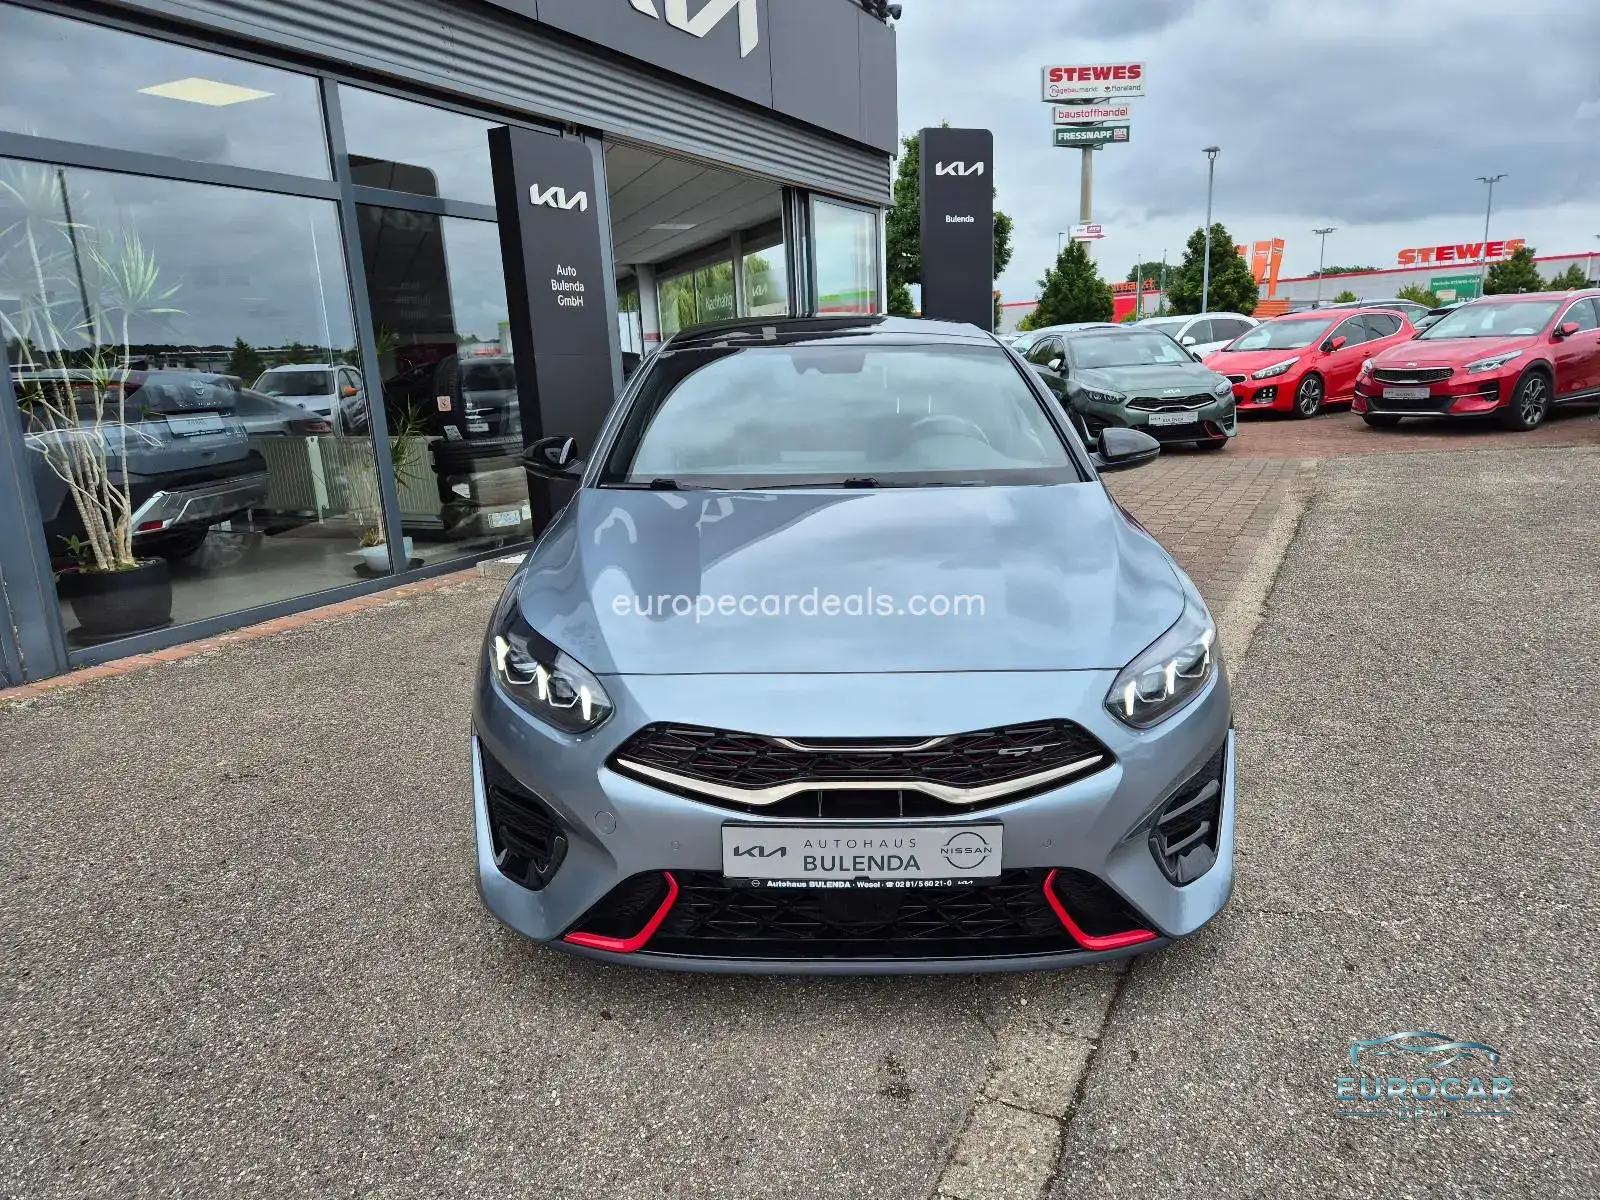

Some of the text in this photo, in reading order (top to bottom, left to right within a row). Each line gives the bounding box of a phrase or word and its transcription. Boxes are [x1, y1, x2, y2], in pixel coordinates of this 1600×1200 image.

[628, 0, 759, 58] IA
[1049, 64, 1142, 82] STEWES
[1058, 107, 1128, 119] baustoffhandel
[1058, 130, 1113, 140] FRESSNAPF
[936, 161, 985, 176] KIA
[529, 183, 588, 212] KIA
[945, 214, 975, 223] Bulenda
[1397, 238, 1526, 265] STEWES
[556, 264, 577, 276] Auto
[551, 279, 585, 292] Bulenda
[557, 294, 584, 307] GmbH
[803, 838, 917, 849] AUTOHAUS
[733, 845, 993, 858] KIA NISSAN
[803, 854, 921, 872] BULENDA
[766, 880, 808, 889] Autohaus
[809, 880, 851, 889] BULENDA
[856, 881, 881, 889] Wesel
